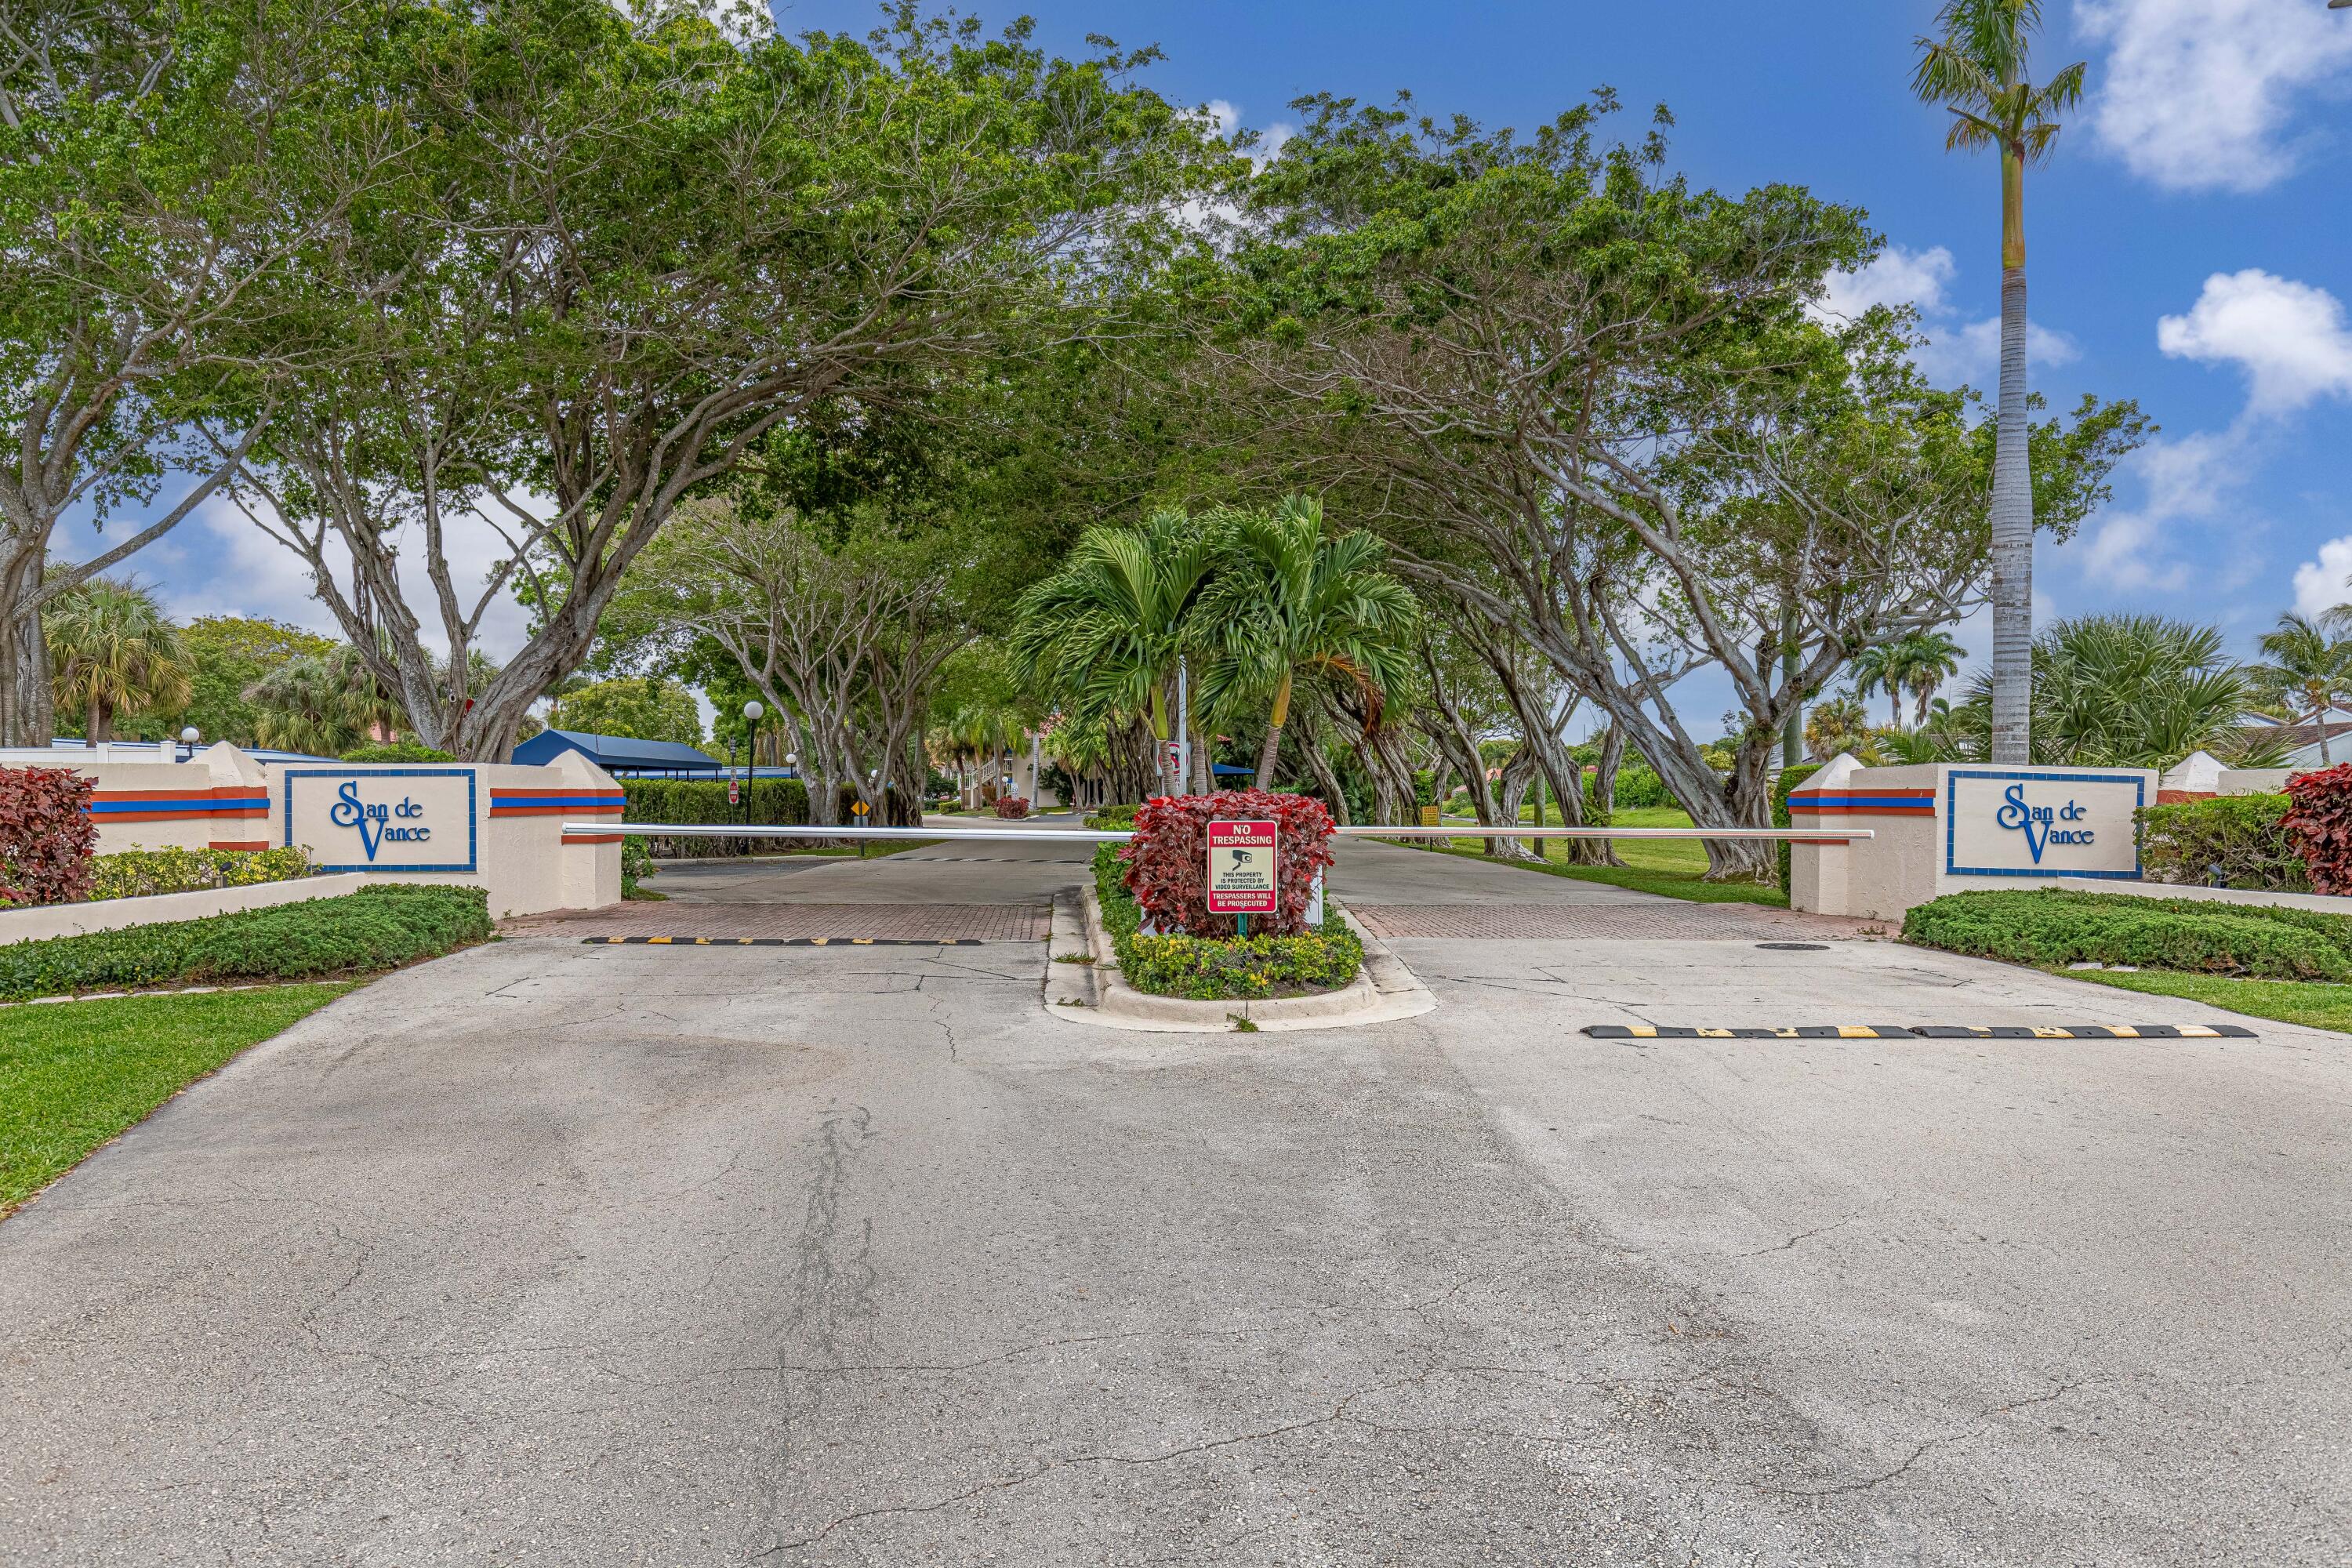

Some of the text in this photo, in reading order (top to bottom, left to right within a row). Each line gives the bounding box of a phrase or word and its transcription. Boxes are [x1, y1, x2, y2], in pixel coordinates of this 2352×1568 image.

[330, 780, 423, 827] San de
[1997, 783, 2087, 829] San de
[353, 818, 430, 862] Vance
[1212, 836, 1272, 844] TRESPASSING
[1233, 825, 1251, 835] NO
[2018, 820, 2095, 865] Vance
